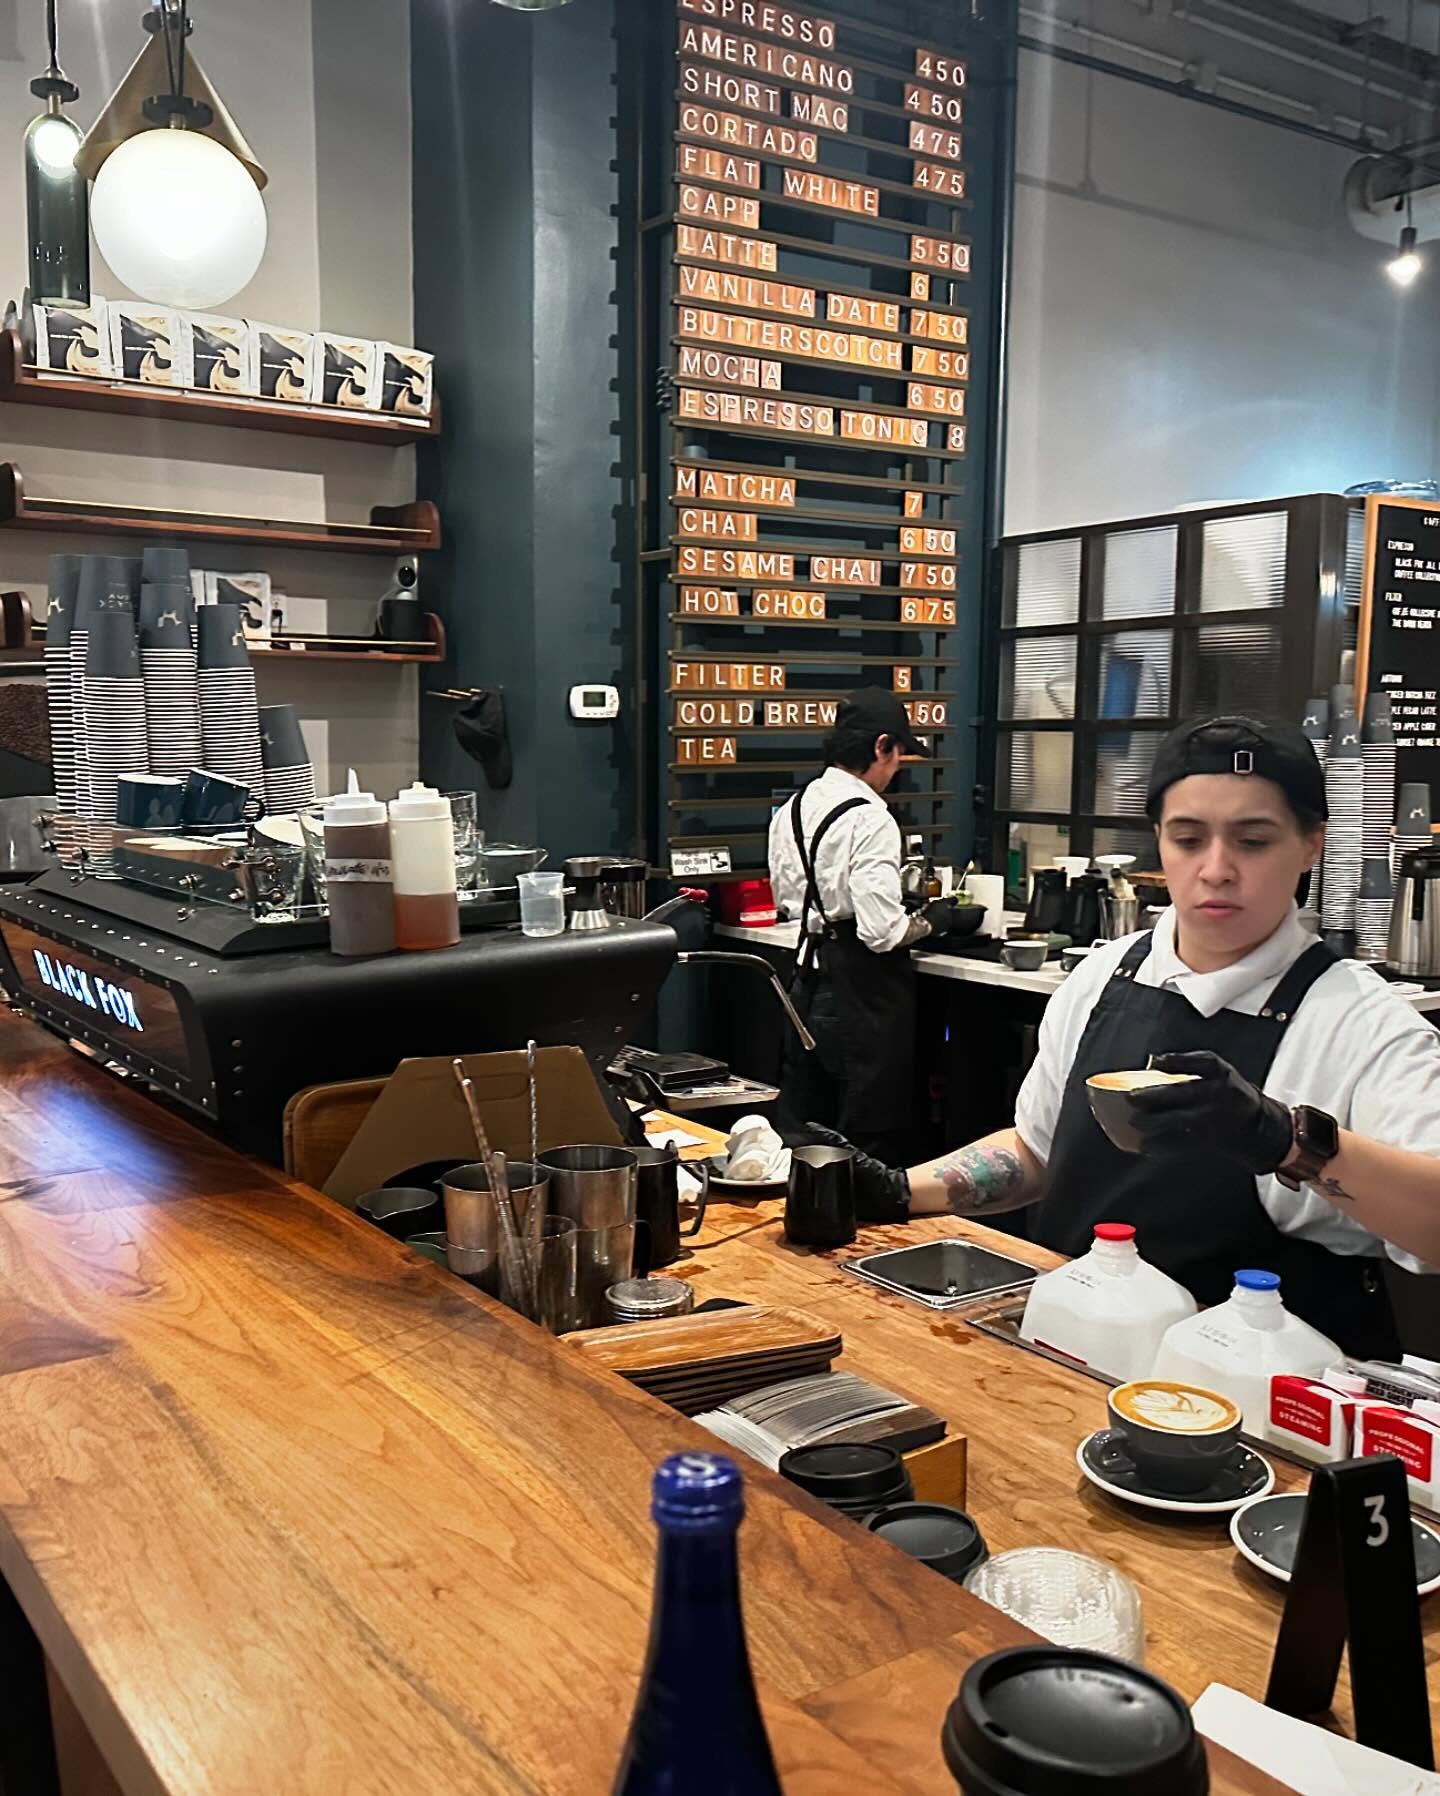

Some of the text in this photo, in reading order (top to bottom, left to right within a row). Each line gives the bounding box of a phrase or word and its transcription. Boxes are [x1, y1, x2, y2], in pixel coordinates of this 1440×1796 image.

[682, 28, 961, 121] AMERICANO 450
[919, 56, 965, 86] 450
[683, 68, 960, 158] SHORT MAC 475
[682, 108, 963, 195] CORTADO 475
[684, 149, 877, 213] FLAT WHITE
[683, 188, 969, 268] CAPP 550
[682, 230, 926, 296] LATTE 6
[682, 268, 966, 338] VANILLA DATE 750
[683, 311, 967, 376] BUTTERSCOTCH 750
[682, 351, 963, 411] MOCHA 650
[684, 393, 963, 448] ESPRESSO TONIC 8
[677, 469, 920, 513] MATCHA 7
[682, 511, 955, 552] CHAI 650
[683, 549, 955, 586] SESAME CHAI 750
[685, 591, 954, 621] HOT CHOC 675
[676, 664, 909, 688] FILTER 5
[680, 702, 754, 724] COLD
[768, 703, 837, 724] BREW
[682, 738, 735, 759] TEA
[33, 949, 144, 1032] BLACK FOX
[1364, 1494, 1390, 1547] 3
